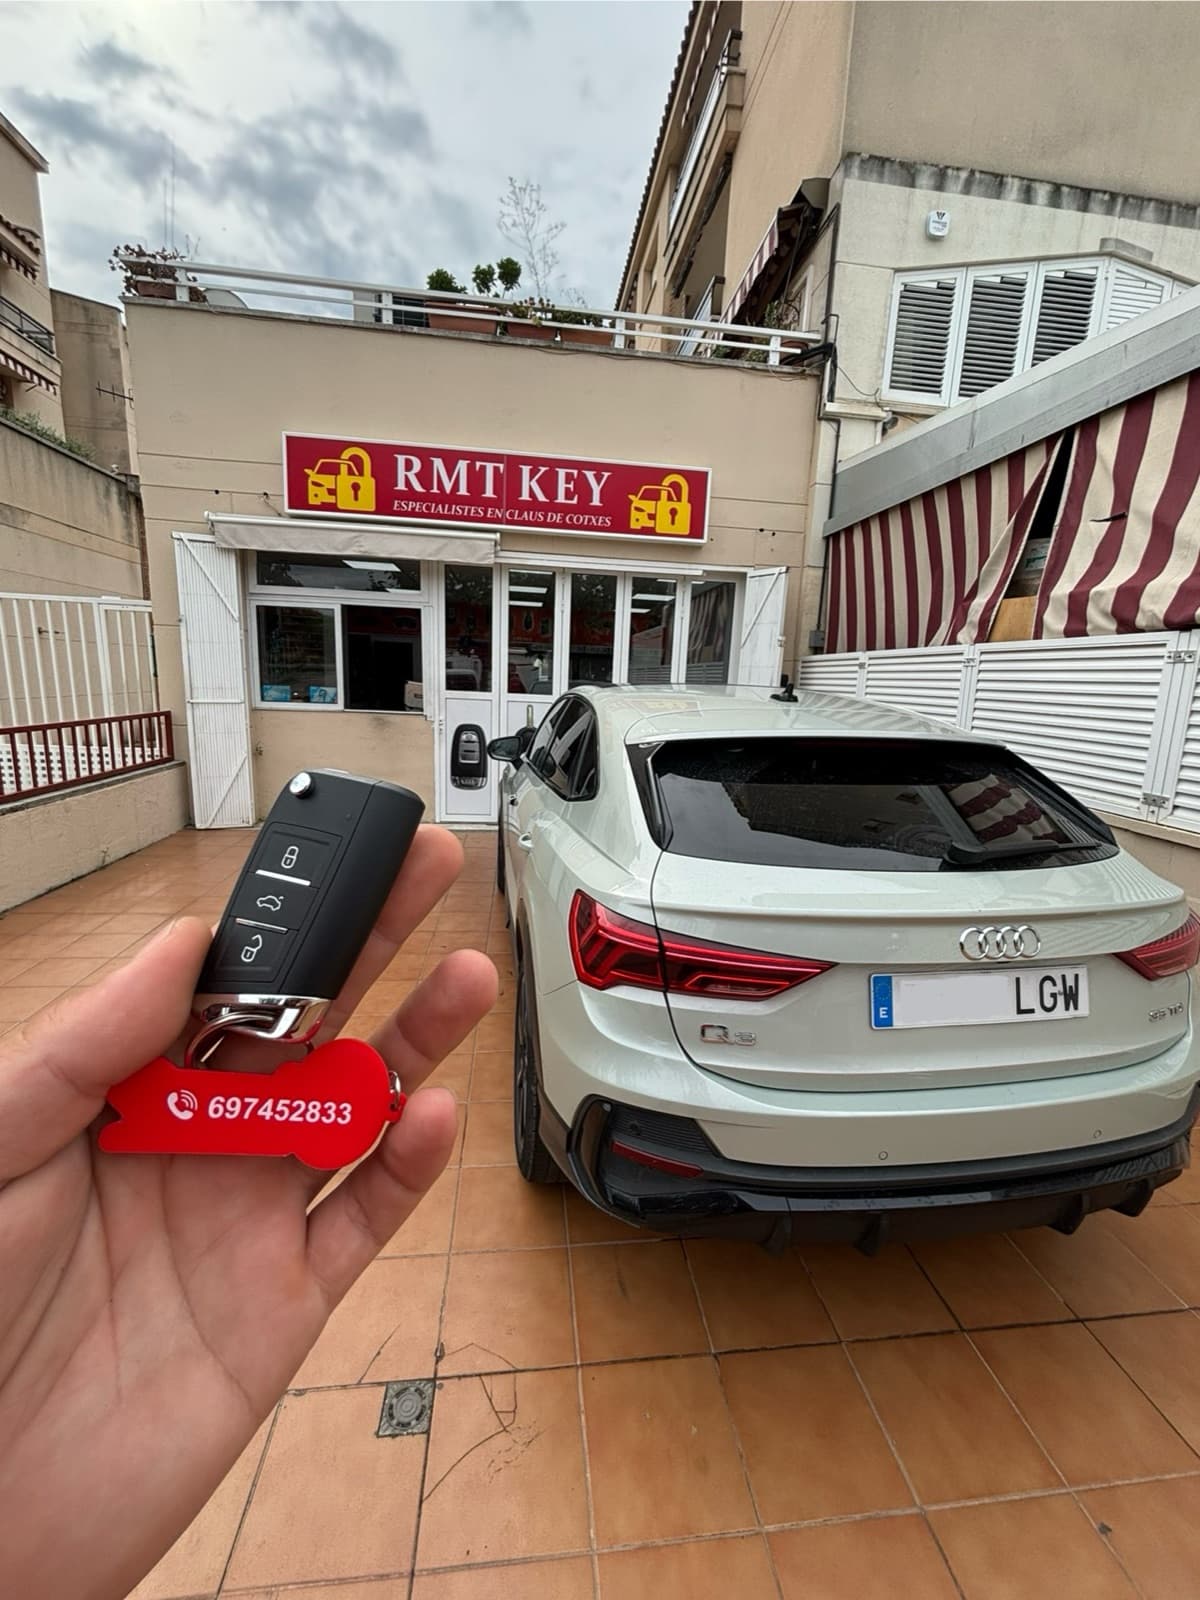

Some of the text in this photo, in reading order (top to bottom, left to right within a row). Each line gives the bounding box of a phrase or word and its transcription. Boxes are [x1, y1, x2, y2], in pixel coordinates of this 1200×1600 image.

[393, 454, 612, 506] RMT KEY
[393, 500, 612, 527] ESPECIALISTES EN CLAUS DE COTXES
[1015, 973, 1080, 1015] LGW
[879, 1007, 889, 1018] E
[700, 1023, 756, 1046] Q3
[207, 1095, 352, 1125] 697452833
